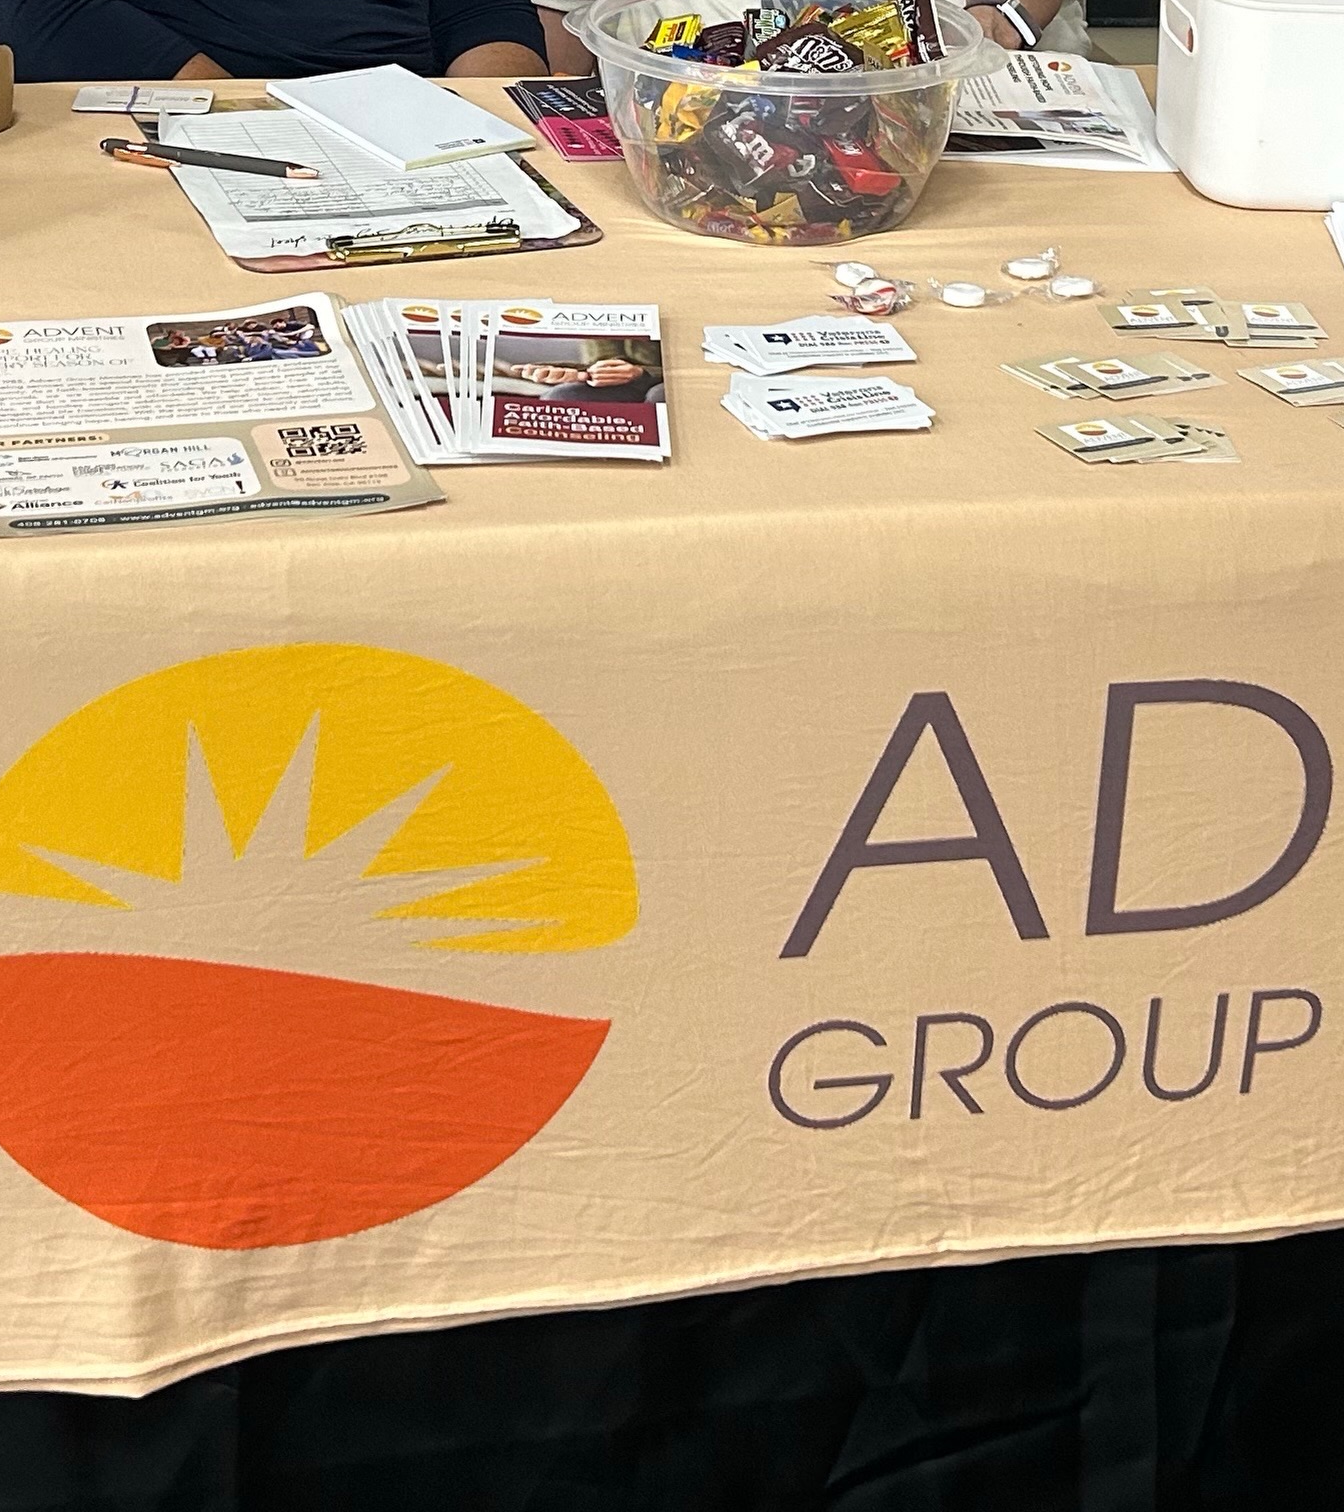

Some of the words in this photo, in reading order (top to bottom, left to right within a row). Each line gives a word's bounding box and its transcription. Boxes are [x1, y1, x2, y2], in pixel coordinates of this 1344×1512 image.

[553, 312, 648, 322] ADVENT
[23, 326, 125, 338] ADVENT
[504, 404, 587, 416] Caring,
[504, 412, 633, 425] Affordable,
[504, 420, 644, 433] Faith-Based
[11, 435, 104, 446] PARTNERS:
[505, 427, 640, 442] Counseling
[11, 500, 84, 510] Alliance
[767, 987, 1324, 1130] GROUP
